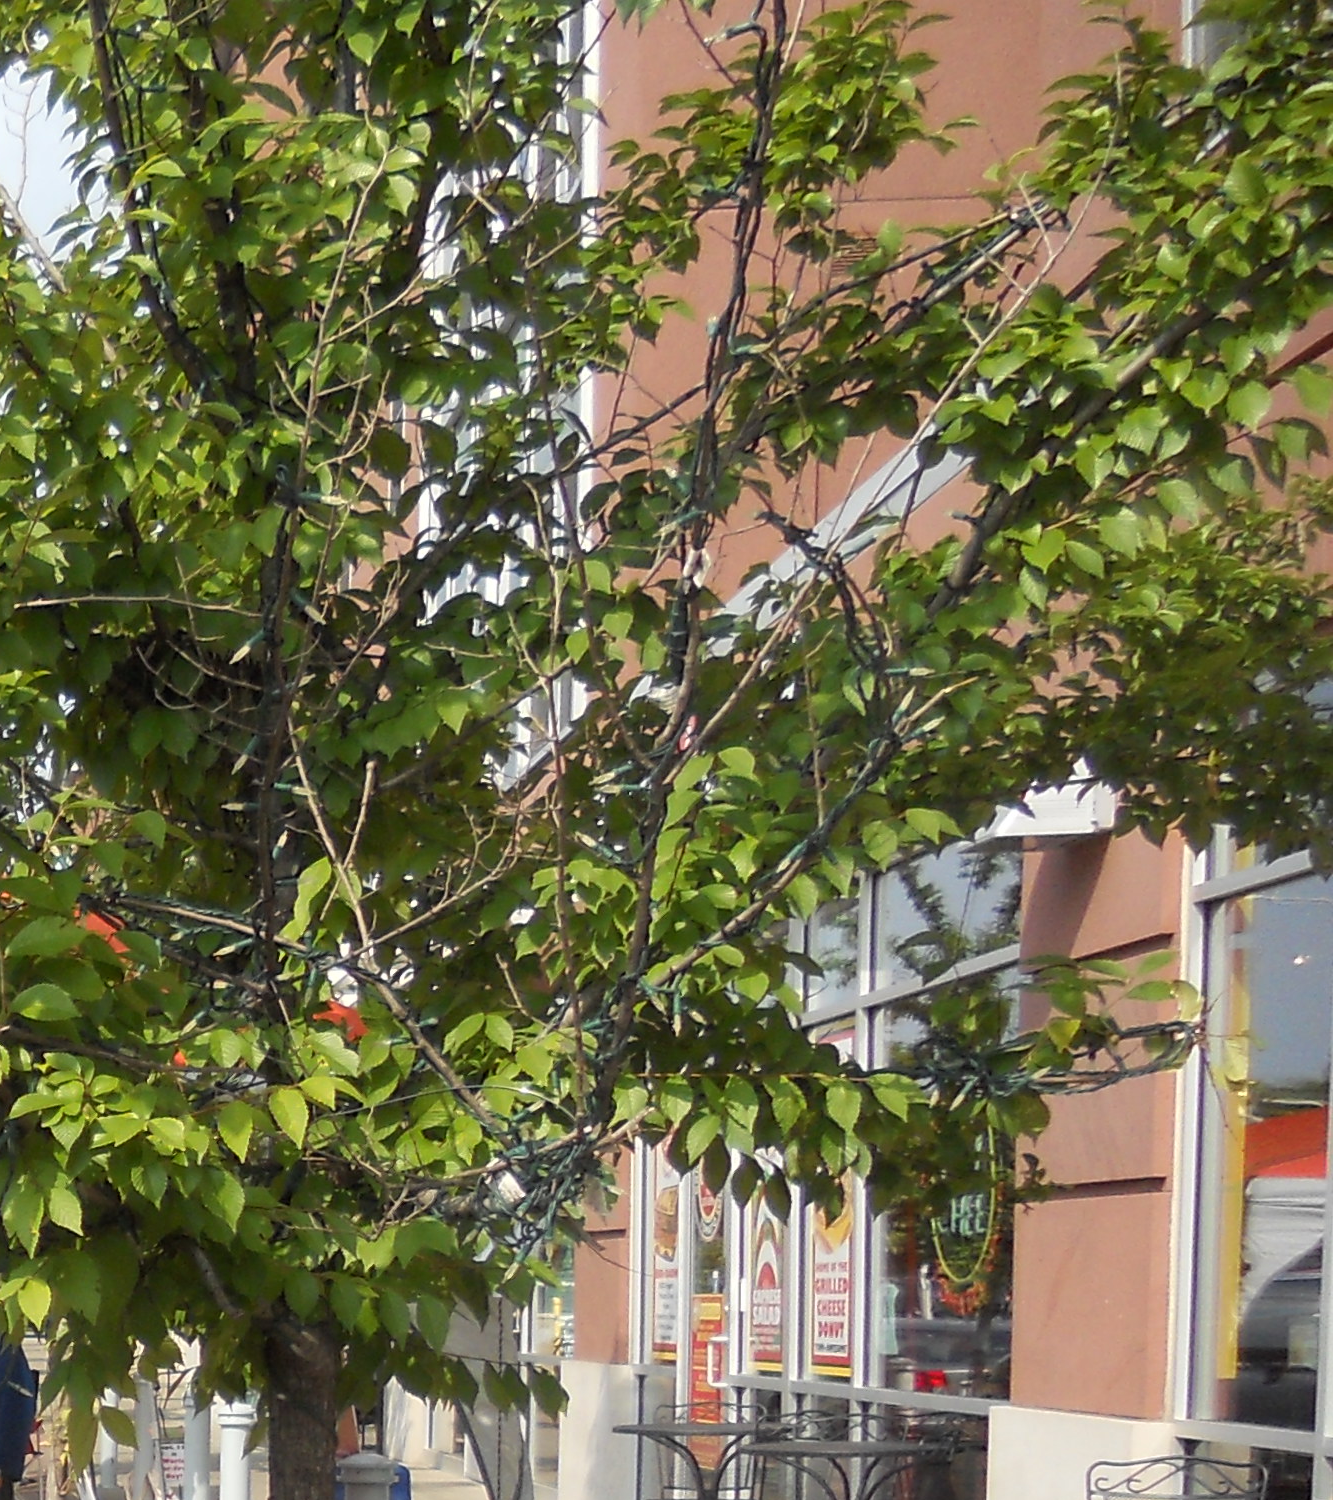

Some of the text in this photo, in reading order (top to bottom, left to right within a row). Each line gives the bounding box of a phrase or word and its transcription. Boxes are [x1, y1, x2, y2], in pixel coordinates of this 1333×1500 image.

[814, 1278, 849, 1294] GRILLED
[753, 1305, 781, 1325] SALAD
[817, 1300, 846, 1316] CHEESE
[818, 1322, 844, 1338] DONUT
